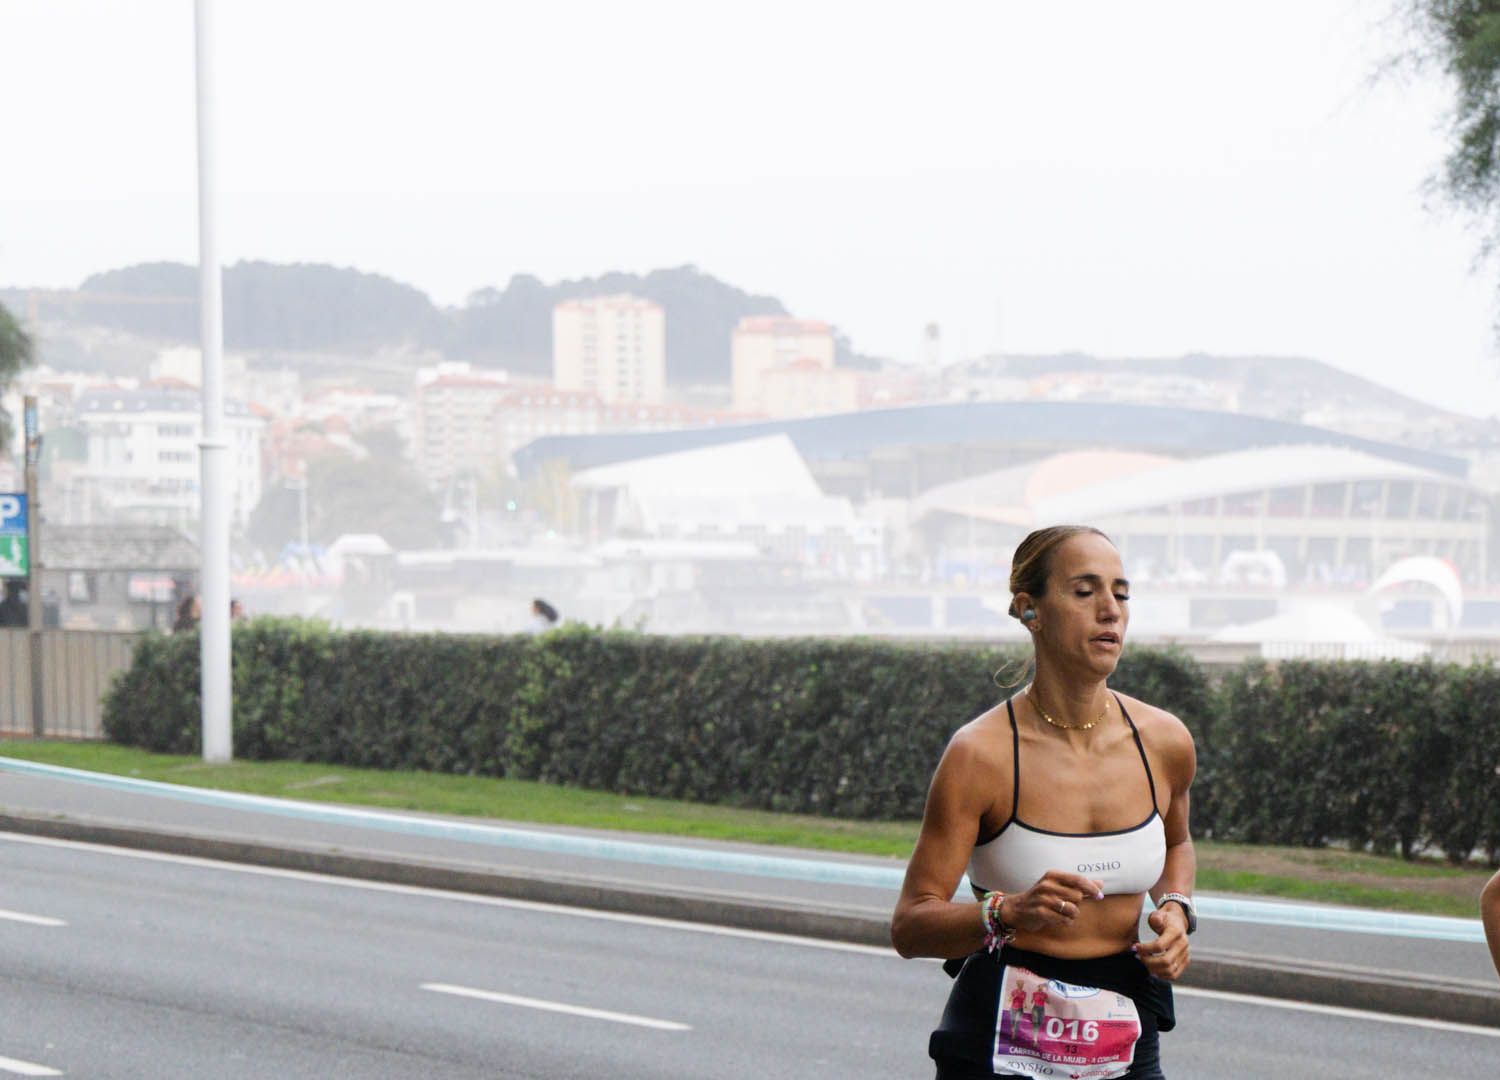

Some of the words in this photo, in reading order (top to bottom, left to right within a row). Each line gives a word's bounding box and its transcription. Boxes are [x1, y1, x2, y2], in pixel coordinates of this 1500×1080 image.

[0, 498, 20, 529] P
[1077, 861, 1120, 872] OYSHO
[1046, 1017, 1099, 1042] 016
[1009, 1046, 1040, 1057] CARRERA
[1042, 1053, 1052, 1061] DE
[1009, 1061, 1053, 1075] OYSHO
